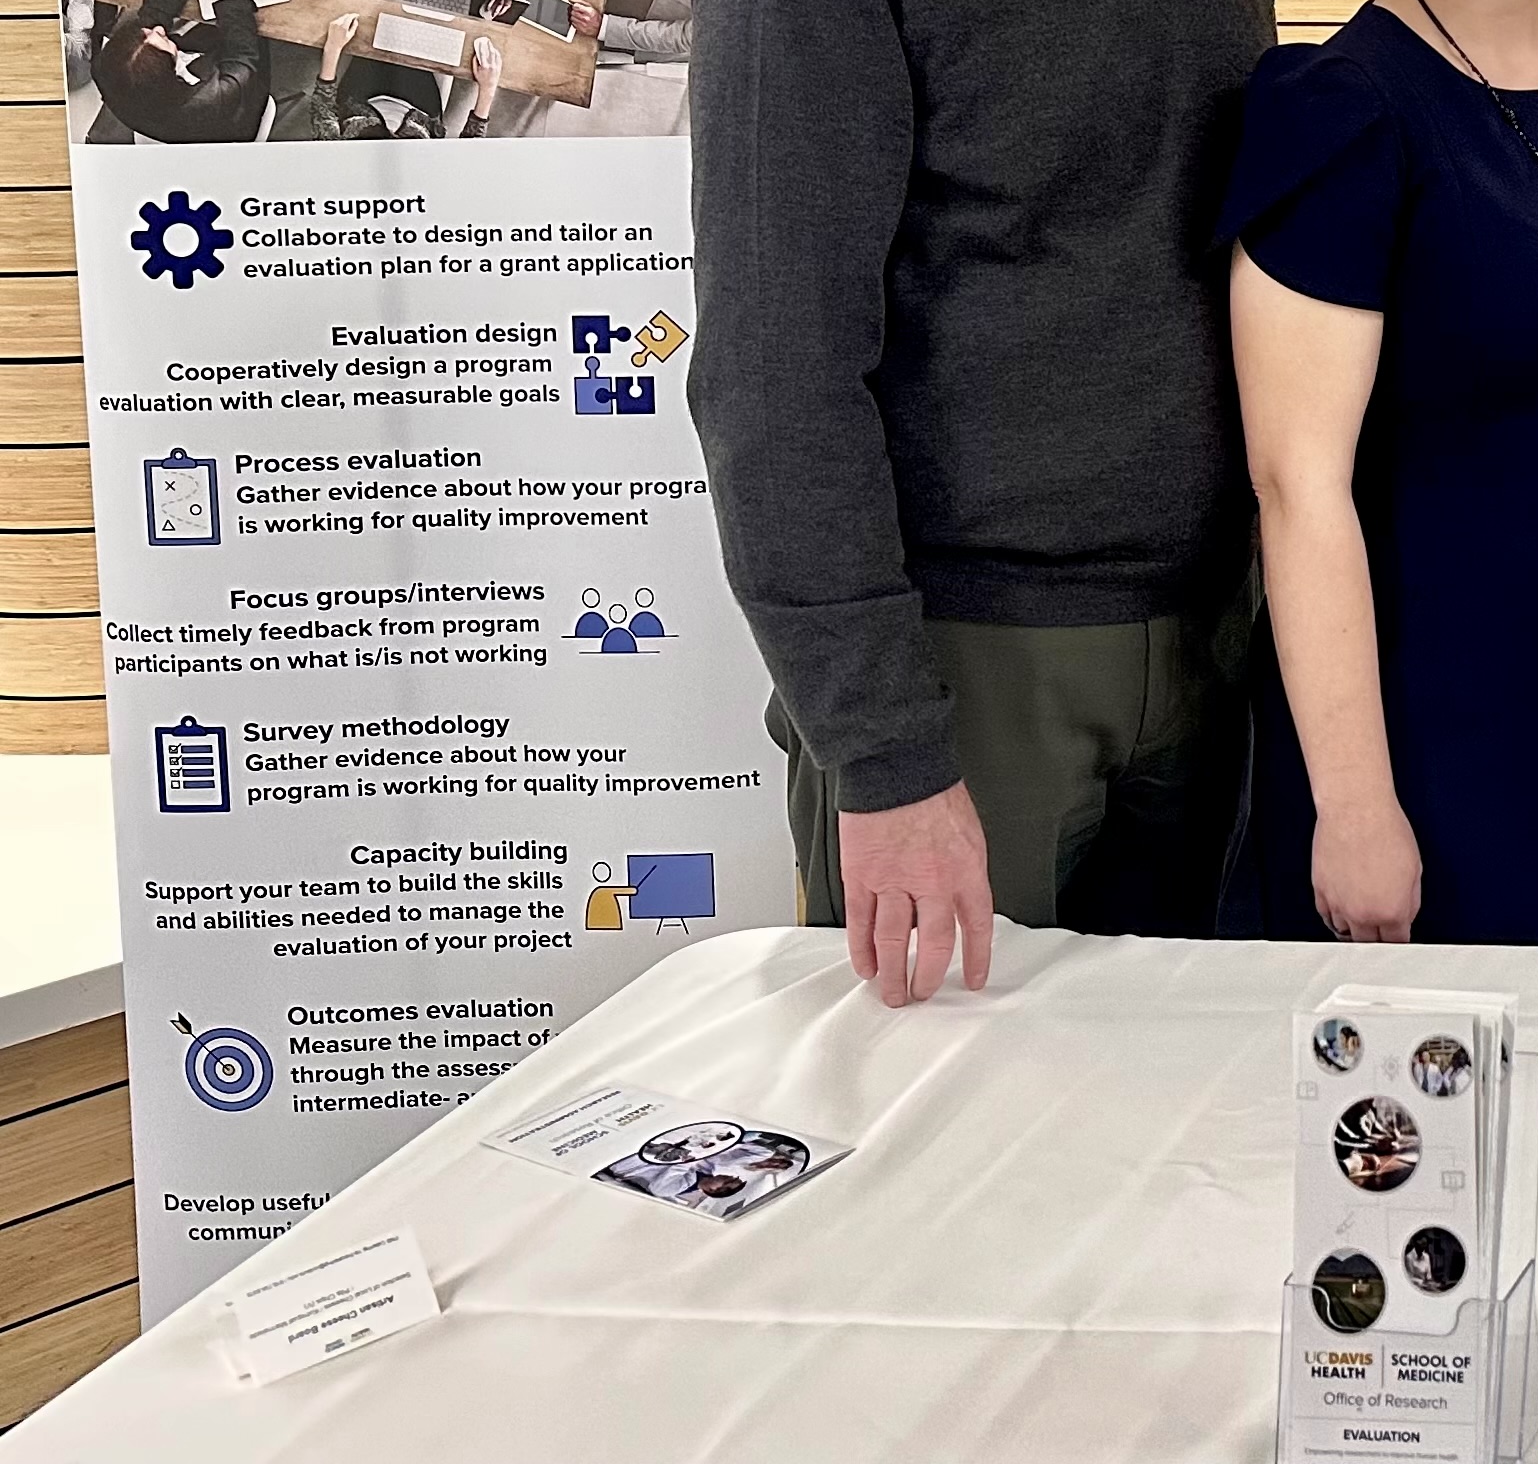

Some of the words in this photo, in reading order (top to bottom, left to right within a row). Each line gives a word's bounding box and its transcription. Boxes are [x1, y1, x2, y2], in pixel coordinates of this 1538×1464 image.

[240, 197, 317, 217] Grant
[323, 195, 426, 220] support
[241, 227, 386, 248] Collaborate
[392, 226, 418, 244] to
[424, 223, 503, 247] design
[510, 223, 552, 242] and
[558, 222, 618, 242] tailor
[624, 227, 653, 241] an
[243, 256, 373, 278] evaluation
[380, 255, 432, 279] plan
[438, 254, 473, 273] for
[479, 258, 492, 273] a
[499, 254, 561, 277] grant
[567, 252, 693, 276] application
[331, 323, 467, 346] Evaluation
[475, 321, 557, 348] design
[166, 358, 339, 385] Cooperatively
[345, 355, 426, 380] design
[433, 359, 447, 374] a
[455, 358, 552, 378] program
[99, 392, 213, 412] evaluation
[219, 390, 273, 411] with
[280, 389, 346, 410] clear,
[353, 384, 493, 406] measurable
[499, 384, 560, 408] goals
[235, 454, 340, 474] Process
[347, 446, 482, 471] evaluation
[236, 484, 321, 505] Gather
[328, 480, 438, 501] evidence
[444, 478, 512, 497] about
[518, 477, 566, 496] how
[571, 482, 623, 501] your
[629, 475, 709, 499] progra
[238, 515, 258, 535] is
[264, 511, 364, 535] working
[370, 510, 405, 530] for
[412, 507, 492, 533] quality
[498, 507, 649, 531] improvement
[230, 589, 309, 610] Focus
[316, 580, 545, 611] groups/interviews
[106, 621, 174, 644] Collect
[178, 623, 253, 647] timely
[258, 618, 373, 641] feedback
[378, 617, 435, 636] from
[442, 618, 540, 638] program
[115, 653, 243, 678] participants
[249, 656, 280, 671] on
[286, 650, 349, 670] what
[355, 646, 403, 667] is/is
[410, 646, 449, 665] not
[454, 643, 547, 667] working
[243, 722, 334, 745] Survey
[341, 714, 510, 739] methodology
[245, 752, 329, 772] Gather
[335, 747, 444, 768] evidence
[450, 745, 518, 764] about
[523, 744, 571, 763] how
[576, 748, 627, 767] your
[247, 783, 350, 806] program
[357, 777, 377, 797] is
[382, 774, 478, 798] working
[484, 774, 518, 793] for
[523, 773, 599, 797] quality
[605, 770, 761, 797] improvement
[350, 841, 463, 869] Capacity
[469, 839, 568, 865] building
[145, 881, 234, 905] Support
[238, 884, 293, 904] your
[298, 880, 360, 897] team
[366, 877, 392, 894] to
[398, 872, 457, 893] build
[462, 872, 501, 891] the
[507, 870, 564, 890] skills
[156, 911, 197, 930] and
[203, 909, 294, 930] abilities
[301, 904, 391, 927] needed
[397, 905, 422, 922] to
[429, 905, 522, 924] manage
[527, 900, 565, 919] the
[273, 934, 398, 957] evaluation
[405, 932, 429, 951] of
[434, 935, 488, 955] your
[494, 929, 573, 953] project
[287, 1005, 419, 1026] Outcomes
[426, 997, 554, 1020] evaluation
[289, 1036, 392, 1055] Measure
[397, 1031, 437, 1050] the
[443, 1029, 522, 1052] impact
[527, 1028, 551, 1047] of
[290, 1062, 385, 1086] through
[390, 1061, 431, 1079] the
[437, 1059, 518, 1078] assess
[292, 1089, 451, 1113] intermediate-
[164, 1193, 255, 1216] Develop
[263, 1193, 330, 1211] useful
[189, 1222, 292, 1240] communi
[360, 1295, 394, 1313] Artisan
[321, 1310, 358, 1327] Cheese
[288, 1325, 319, 1343] Board
[1312, 1367, 1365, 1379] HEALTH
[1392, 1354, 1447, 1366] SCHOOL
[1453, 1356, 1471, 1368] OF
[1398, 1370, 1464, 1383] MEDICINE
[1324, 1392, 1364, 1406] Office
[1368, 1394, 1380, 1406] of
[1385, 1395, 1447, 1409] Research
[1344, 1430, 1420, 1442] EVALUATION
